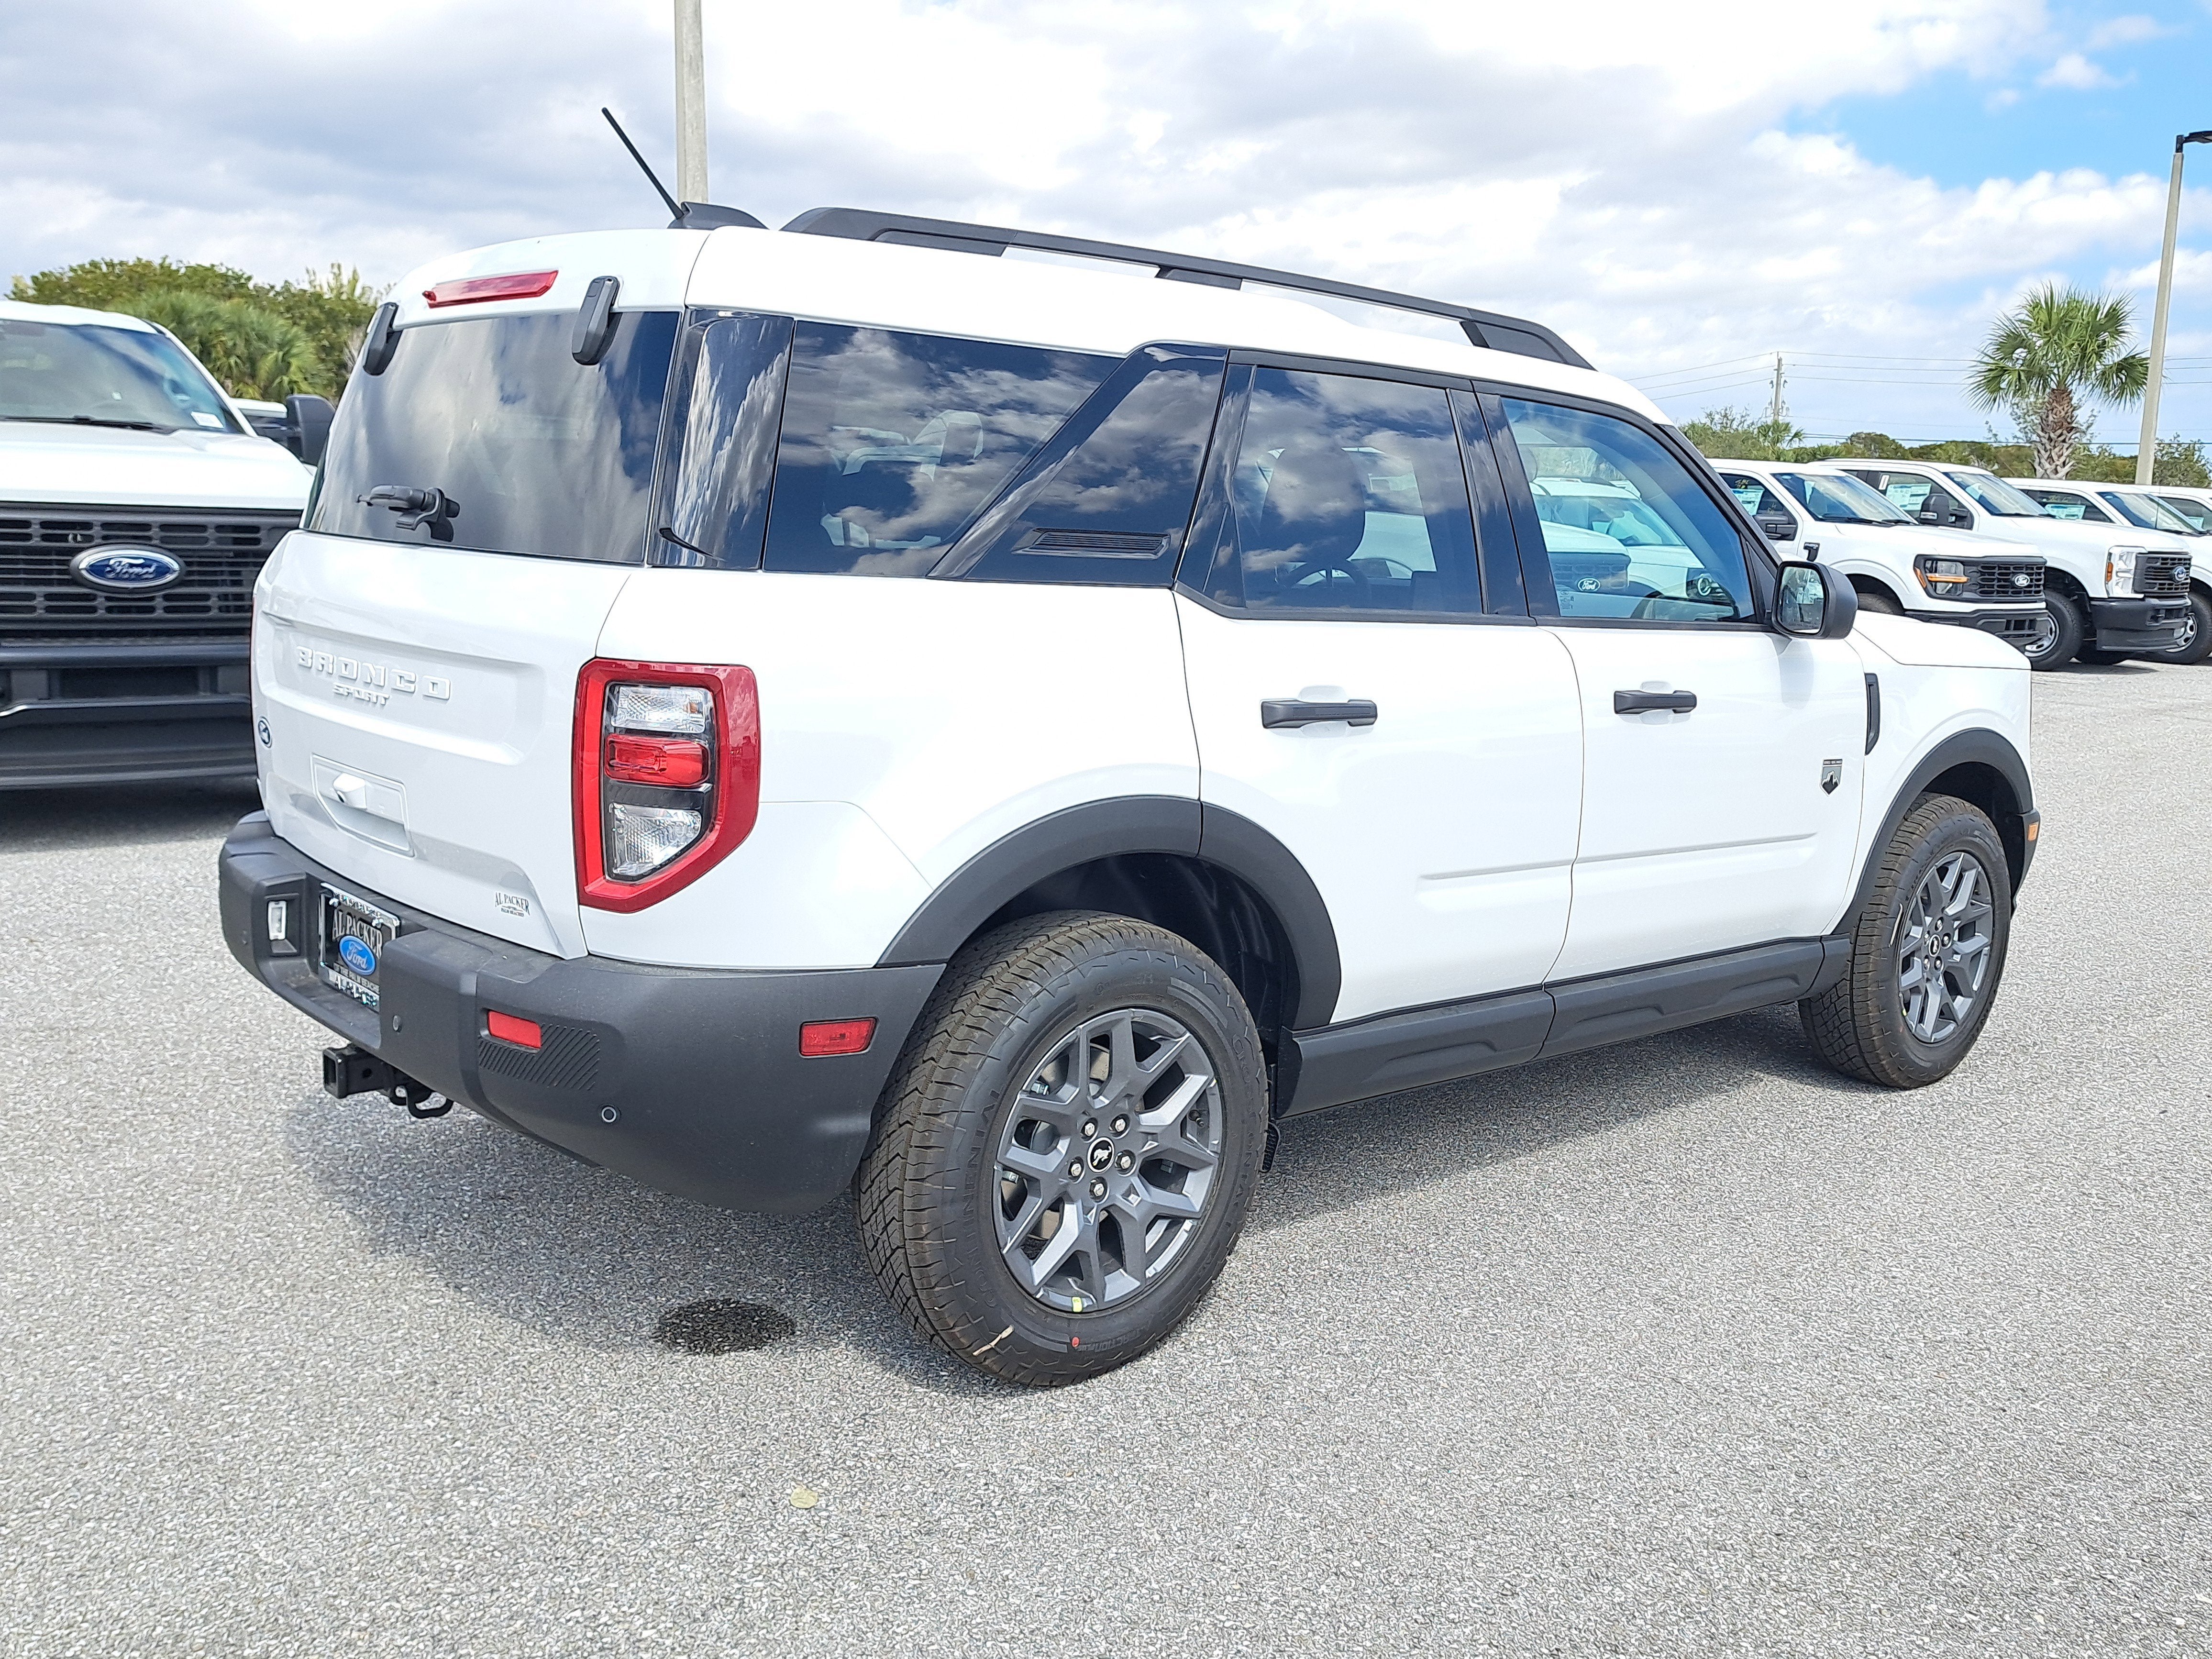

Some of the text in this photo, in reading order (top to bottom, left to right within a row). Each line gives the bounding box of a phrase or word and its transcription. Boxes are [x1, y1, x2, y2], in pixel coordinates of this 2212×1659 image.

[105, 557, 157, 579] Ford
[1582, 580, 1597, 590] Ford
[296, 645, 451, 700] BRONCO
[332, 682, 390, 706] SPORT
[495, 892, 531, 916] AL PACKER
[332, 908, 382, 960] AL PACKER
[346, 941, 368, 969] Ford
[962, 1087, 1001, 1308] CONTINENTAL
